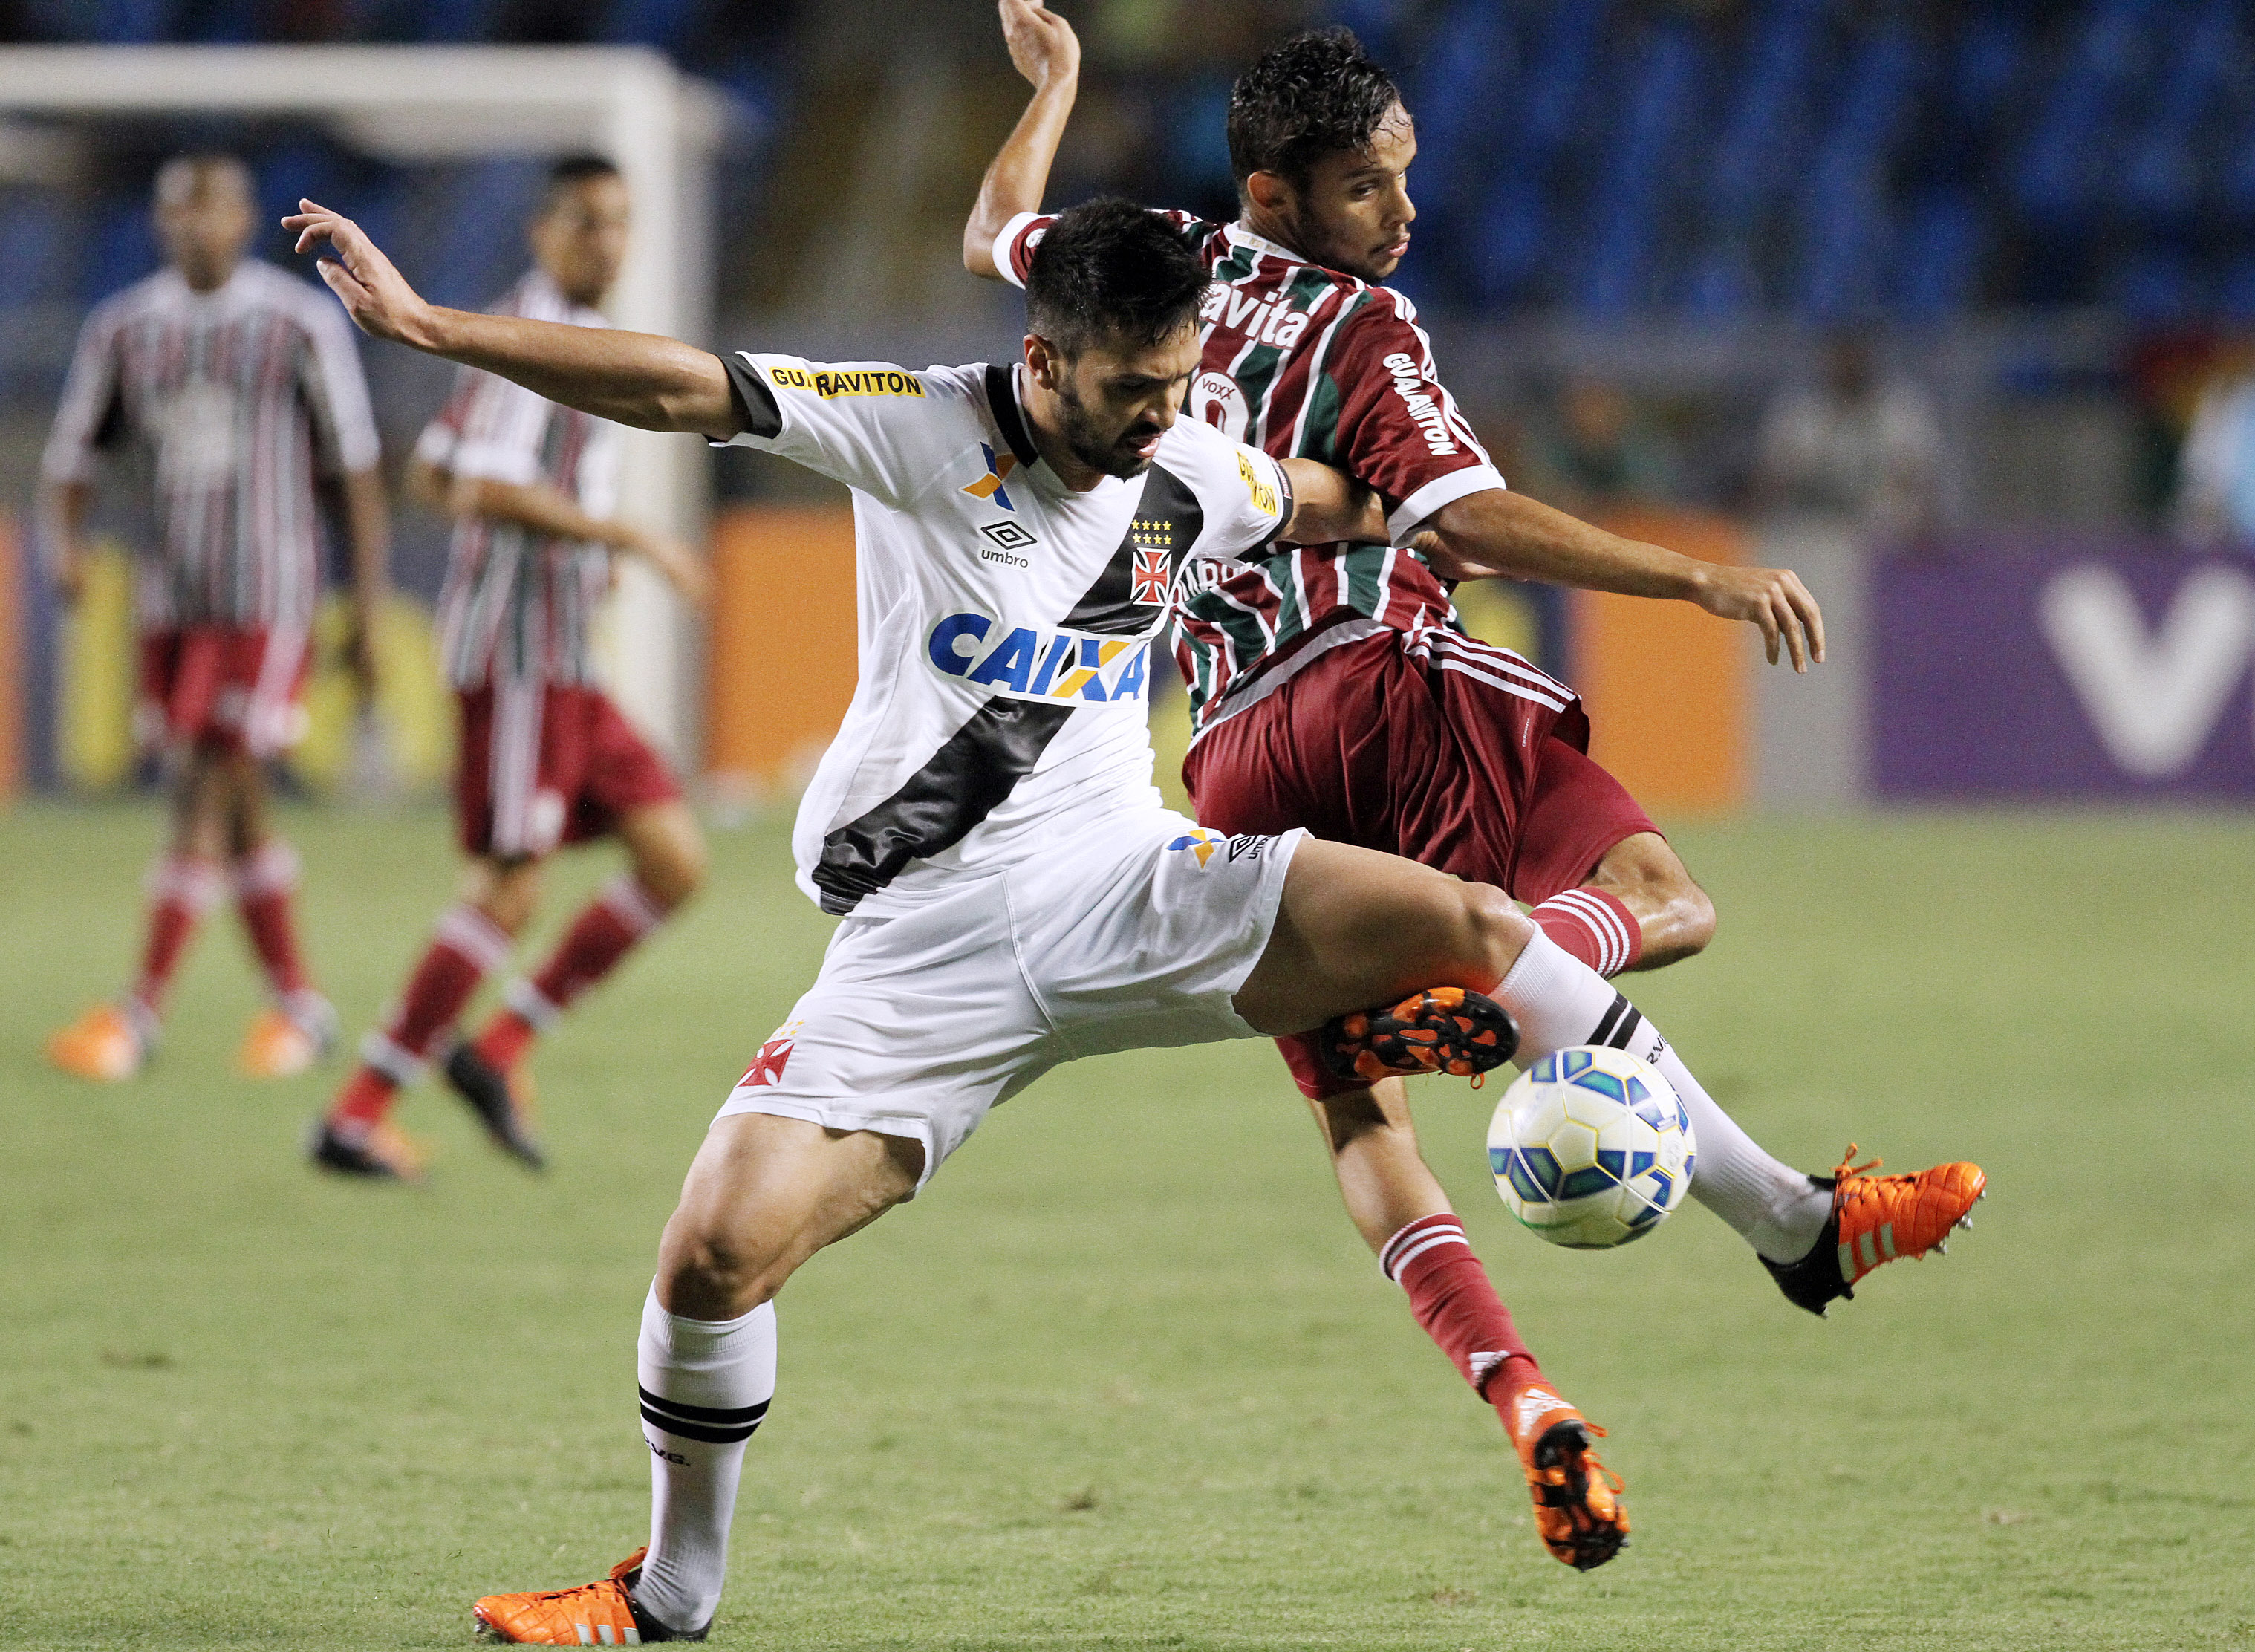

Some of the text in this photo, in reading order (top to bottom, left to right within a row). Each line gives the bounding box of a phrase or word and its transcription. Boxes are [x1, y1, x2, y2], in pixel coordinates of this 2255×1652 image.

[1203, 377, 1236, 400] VOXX
[981, 550, 1028, 568] umbro
[929, 612, 1148, 702] CAIXA
